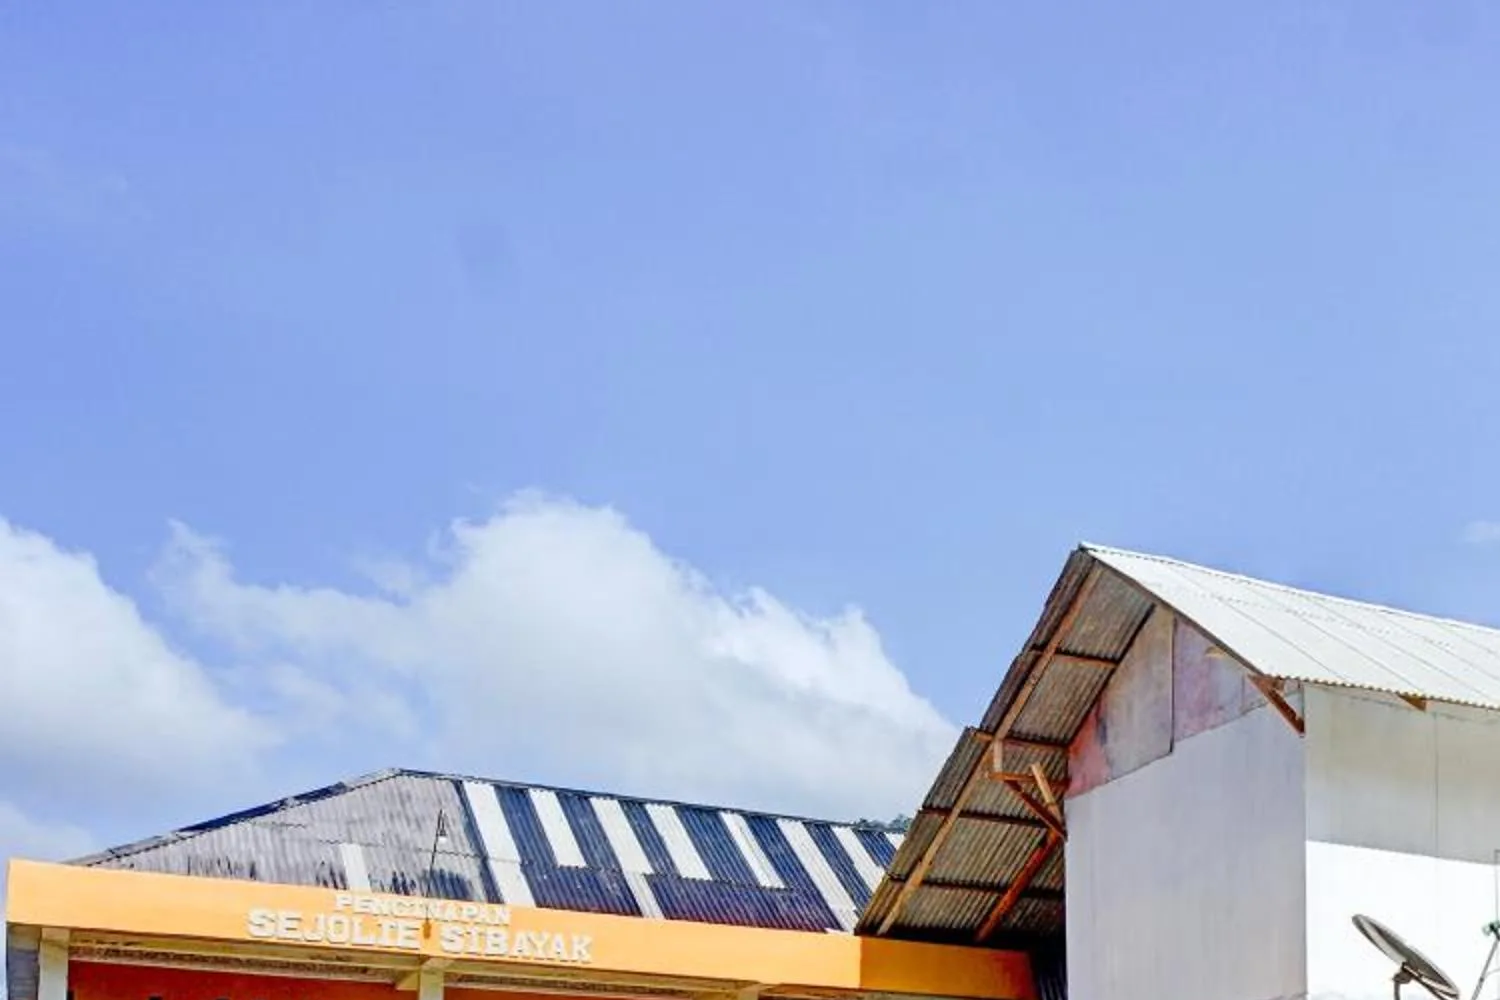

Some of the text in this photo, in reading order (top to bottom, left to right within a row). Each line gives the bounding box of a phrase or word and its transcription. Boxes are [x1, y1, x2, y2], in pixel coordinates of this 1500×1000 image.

[335, 894, 511, 926] PENGINAPAN
[248, 908, 595, 964] SEJOLIE SIBAYAK
